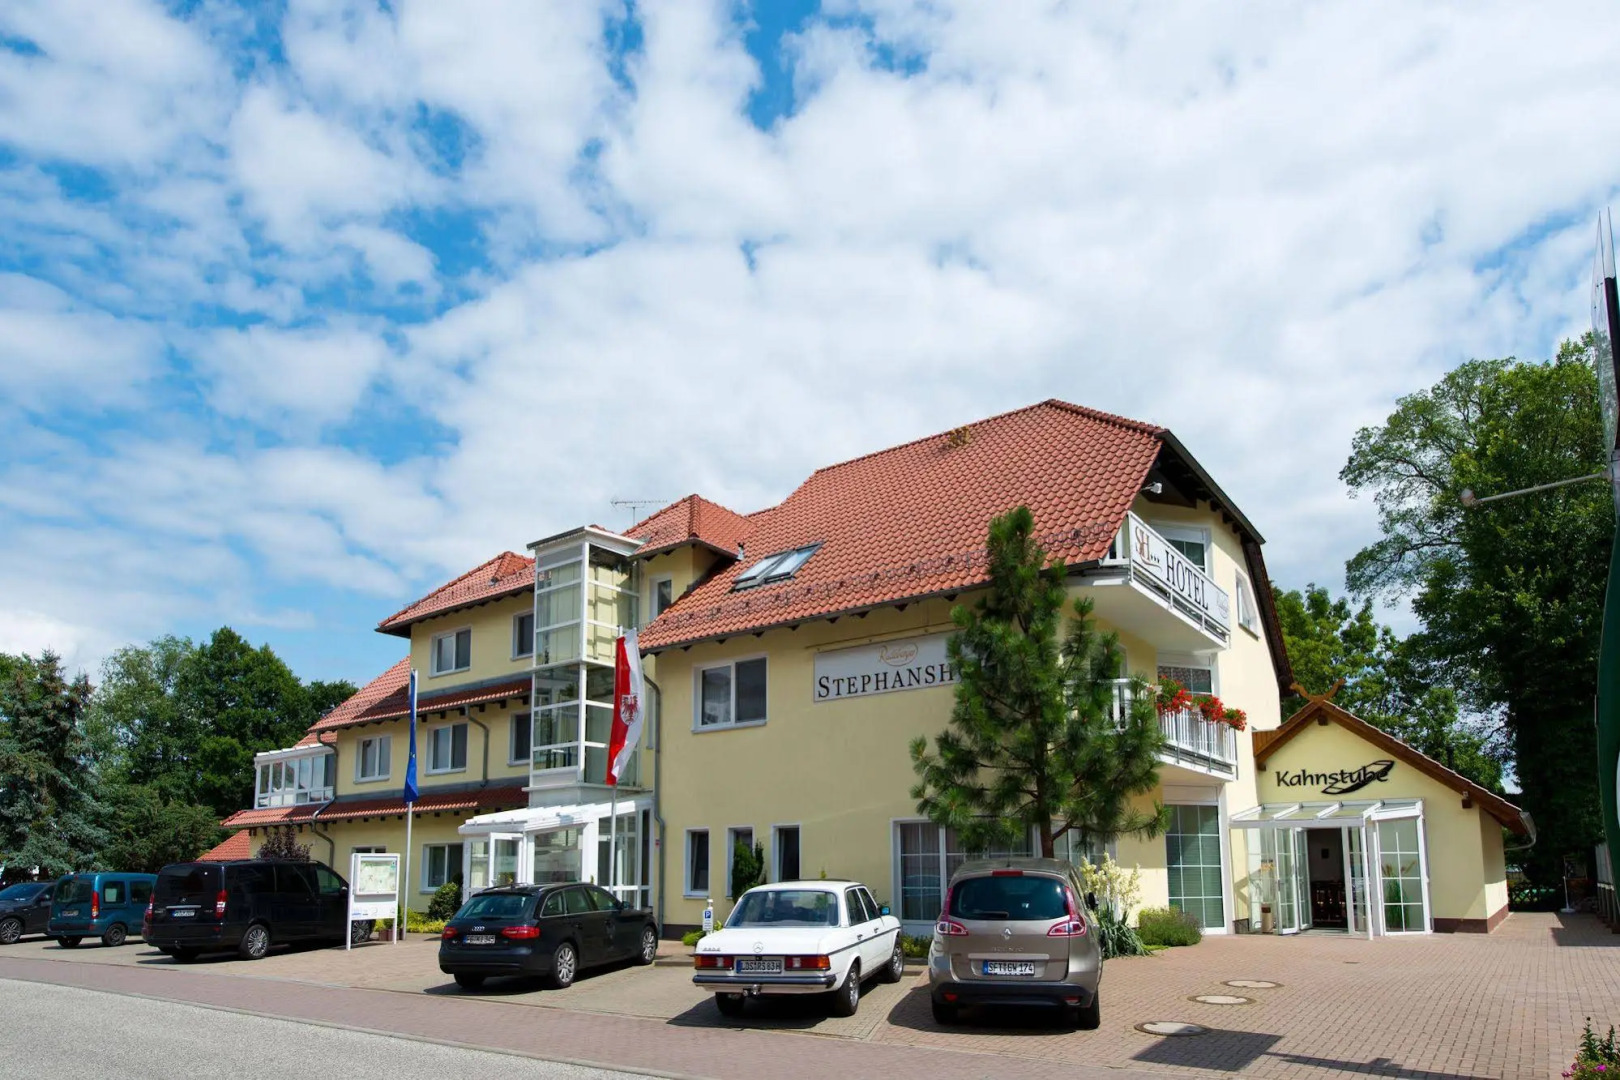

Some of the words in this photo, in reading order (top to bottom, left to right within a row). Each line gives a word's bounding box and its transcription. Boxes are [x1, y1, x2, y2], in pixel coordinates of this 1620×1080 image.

[1165, 549, 1208, 611] HOTEL
[818, 662, 959, 698] STEPHANSH
[1276, 766, 1388, 787] Kahnstube
